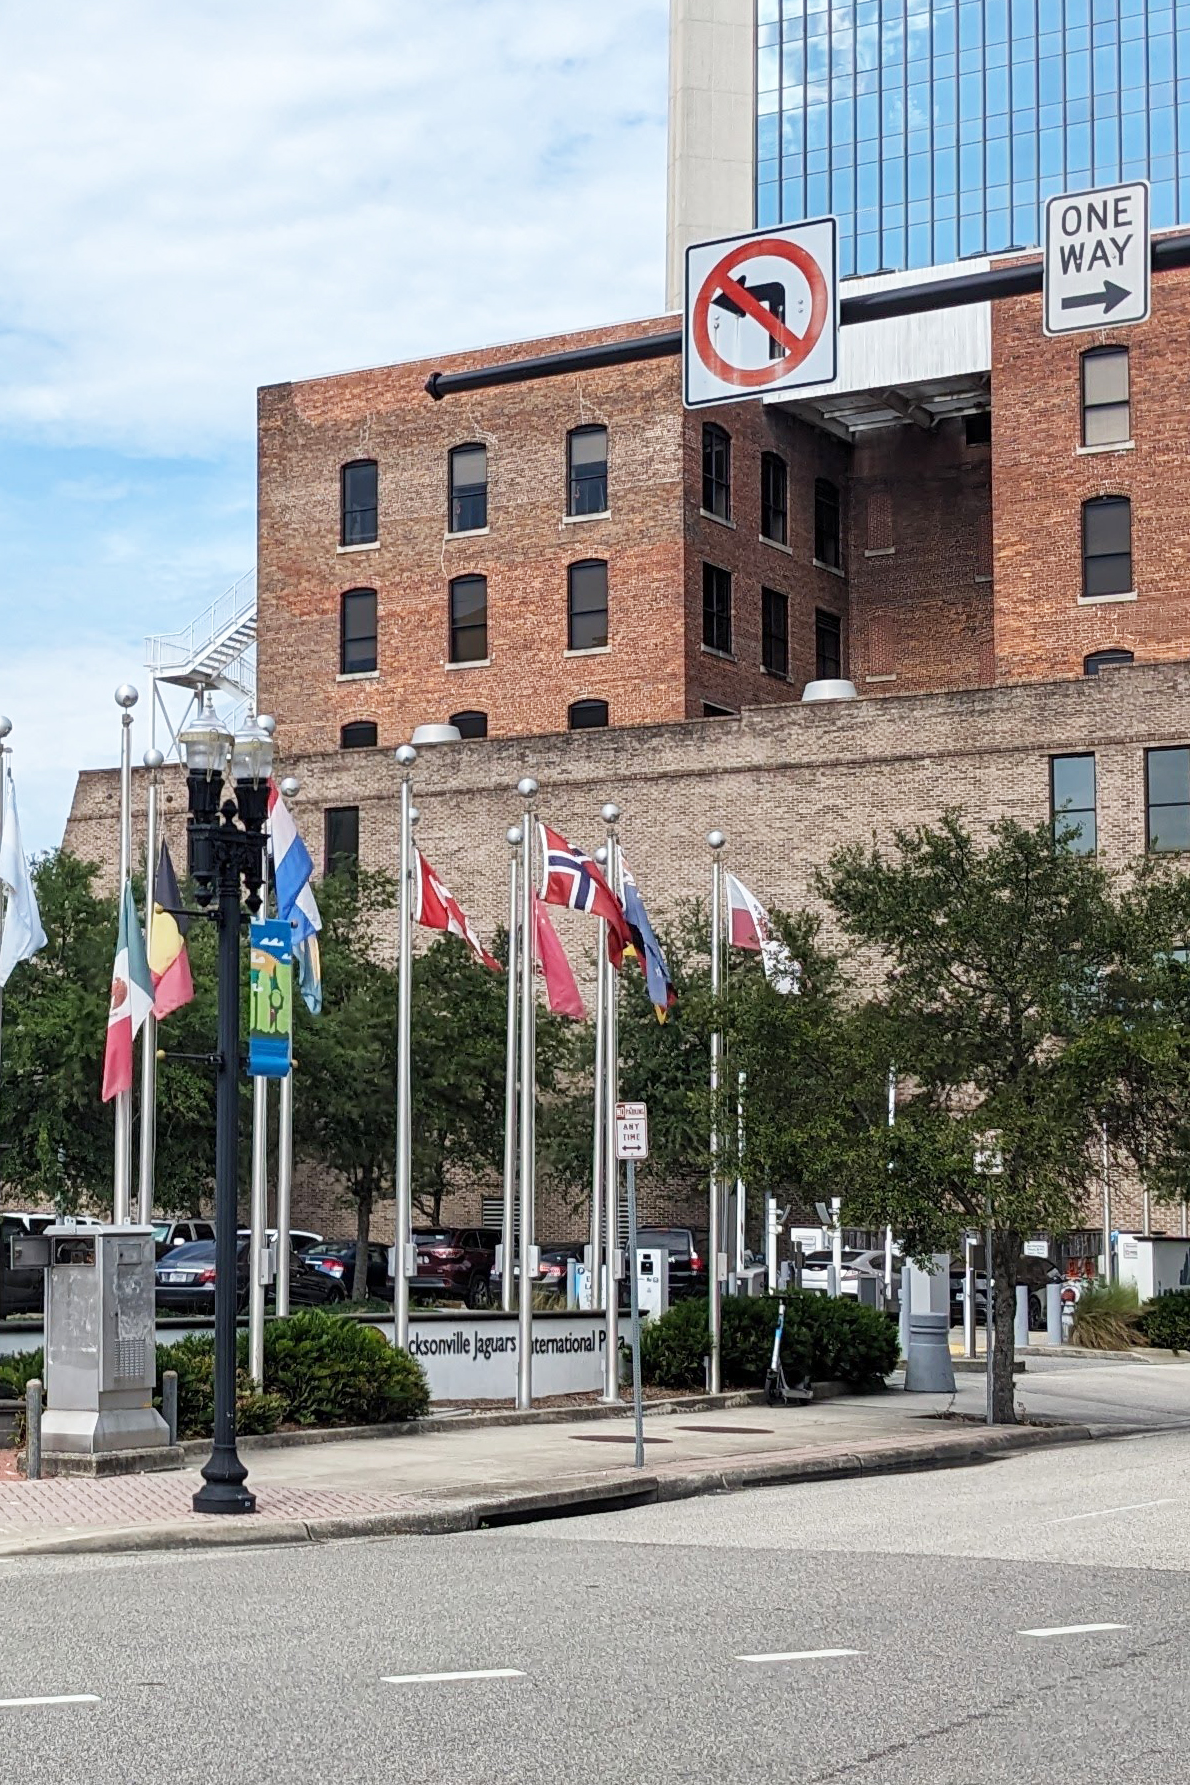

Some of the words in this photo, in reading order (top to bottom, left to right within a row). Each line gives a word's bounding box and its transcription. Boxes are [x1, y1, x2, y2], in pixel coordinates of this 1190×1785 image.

[1062, 195, 1132, 236] ONE
[1060, 234, 1134, 275] WAY
[623, 1133, 640, 1141] TIME
[409, 1331, 471, 1356] cksonville
[473, 1330, 517, 1361] Jaguars
[531, 1330, 596, 1355] ternational
[599, 1330, 625, 1352] Pa
